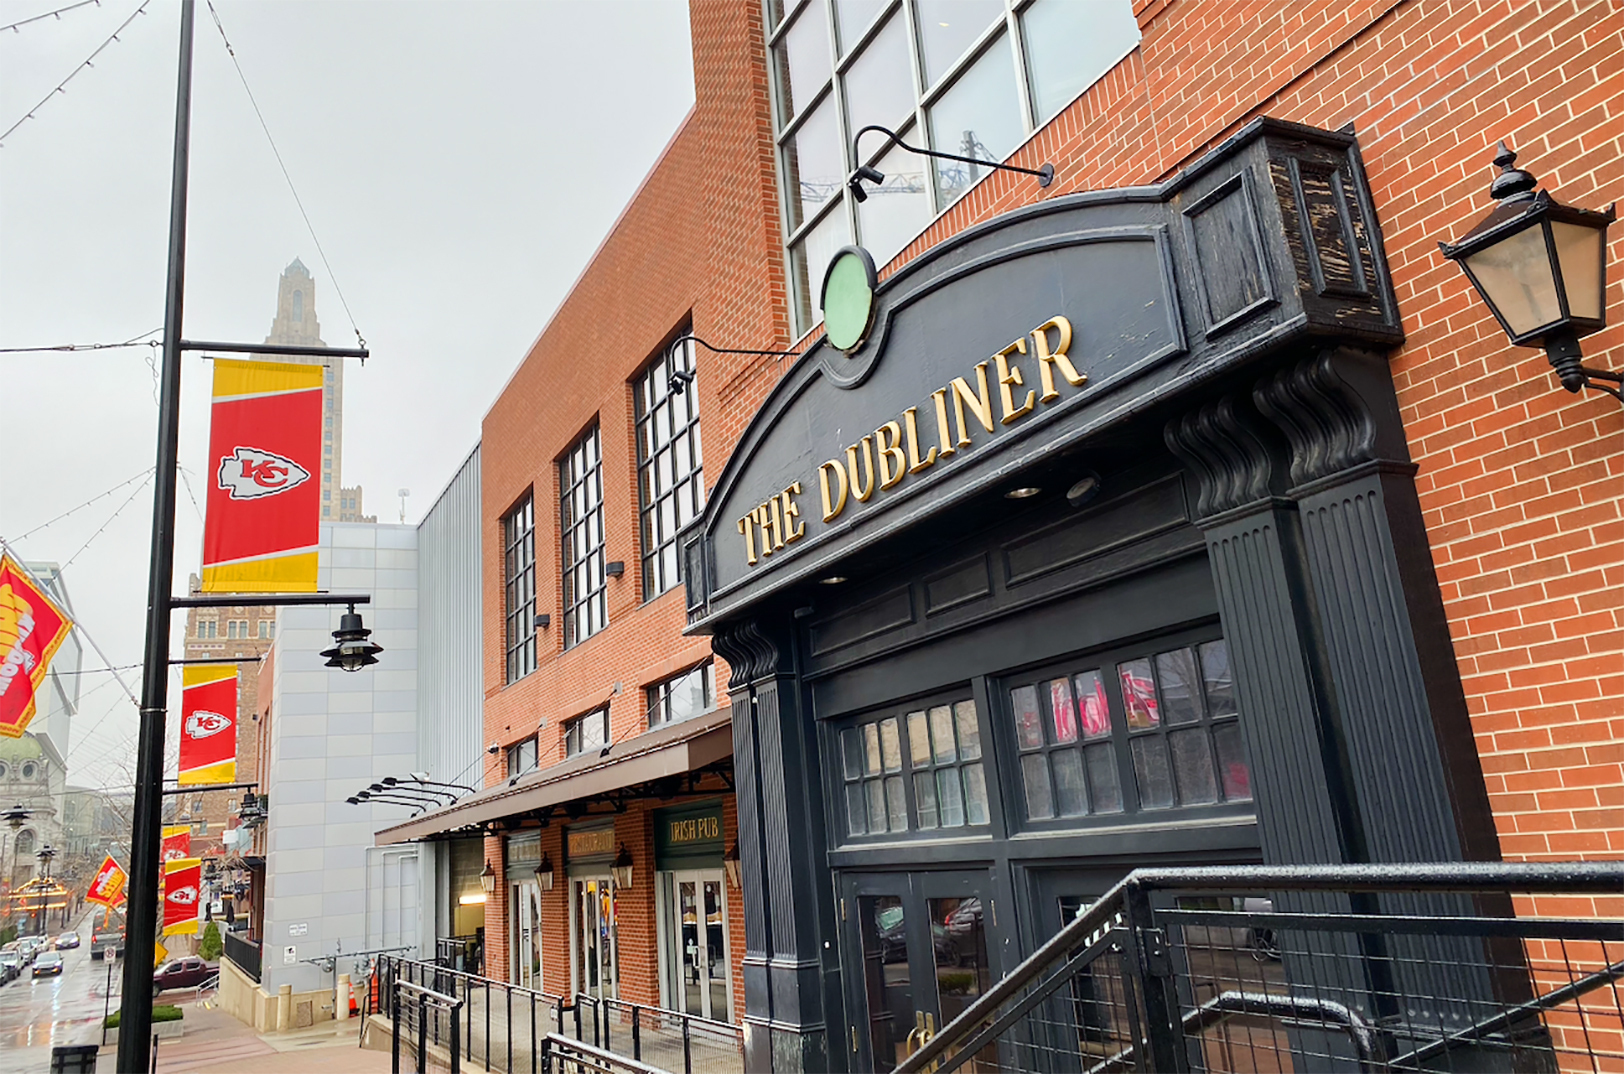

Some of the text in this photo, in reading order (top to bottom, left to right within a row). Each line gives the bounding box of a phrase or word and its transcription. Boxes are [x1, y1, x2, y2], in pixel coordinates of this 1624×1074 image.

[736, 314, 1088, 566] THE DUBLINER
[240, 458, 289, 487] KC
[196, 716, 221, 731] KC
[670, 816, 719, 843] IRISH PUB
